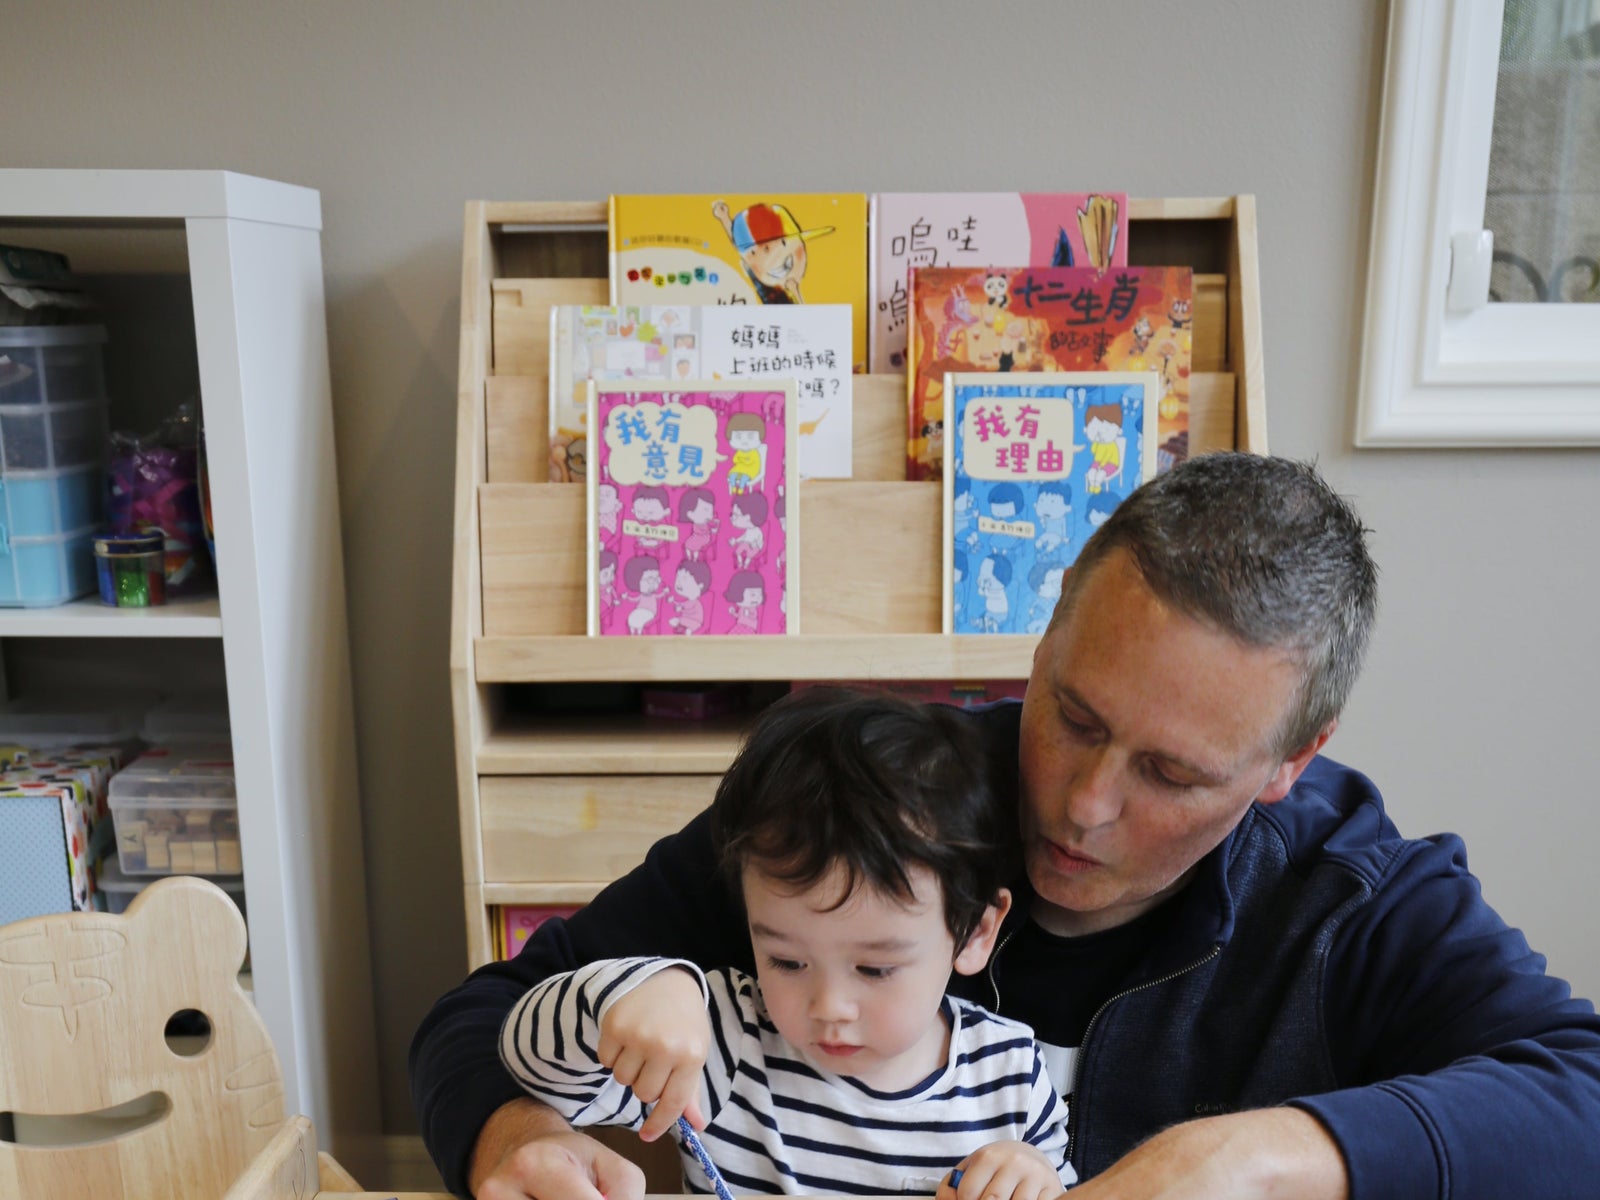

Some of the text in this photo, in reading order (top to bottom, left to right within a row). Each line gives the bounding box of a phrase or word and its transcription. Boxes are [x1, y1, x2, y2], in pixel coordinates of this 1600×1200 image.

[1013, 272, 1141, 326] 十二生肖
[731, 324, 782, 349] 媽媽
[729, 349, 838, 375] 上班的時候
[615, 408, 682, 446] 我有
[972, 403, 1041, 443] 我有
[641, 441, 705, 479] 意見
[995, 439, 1064, 474] 理由
